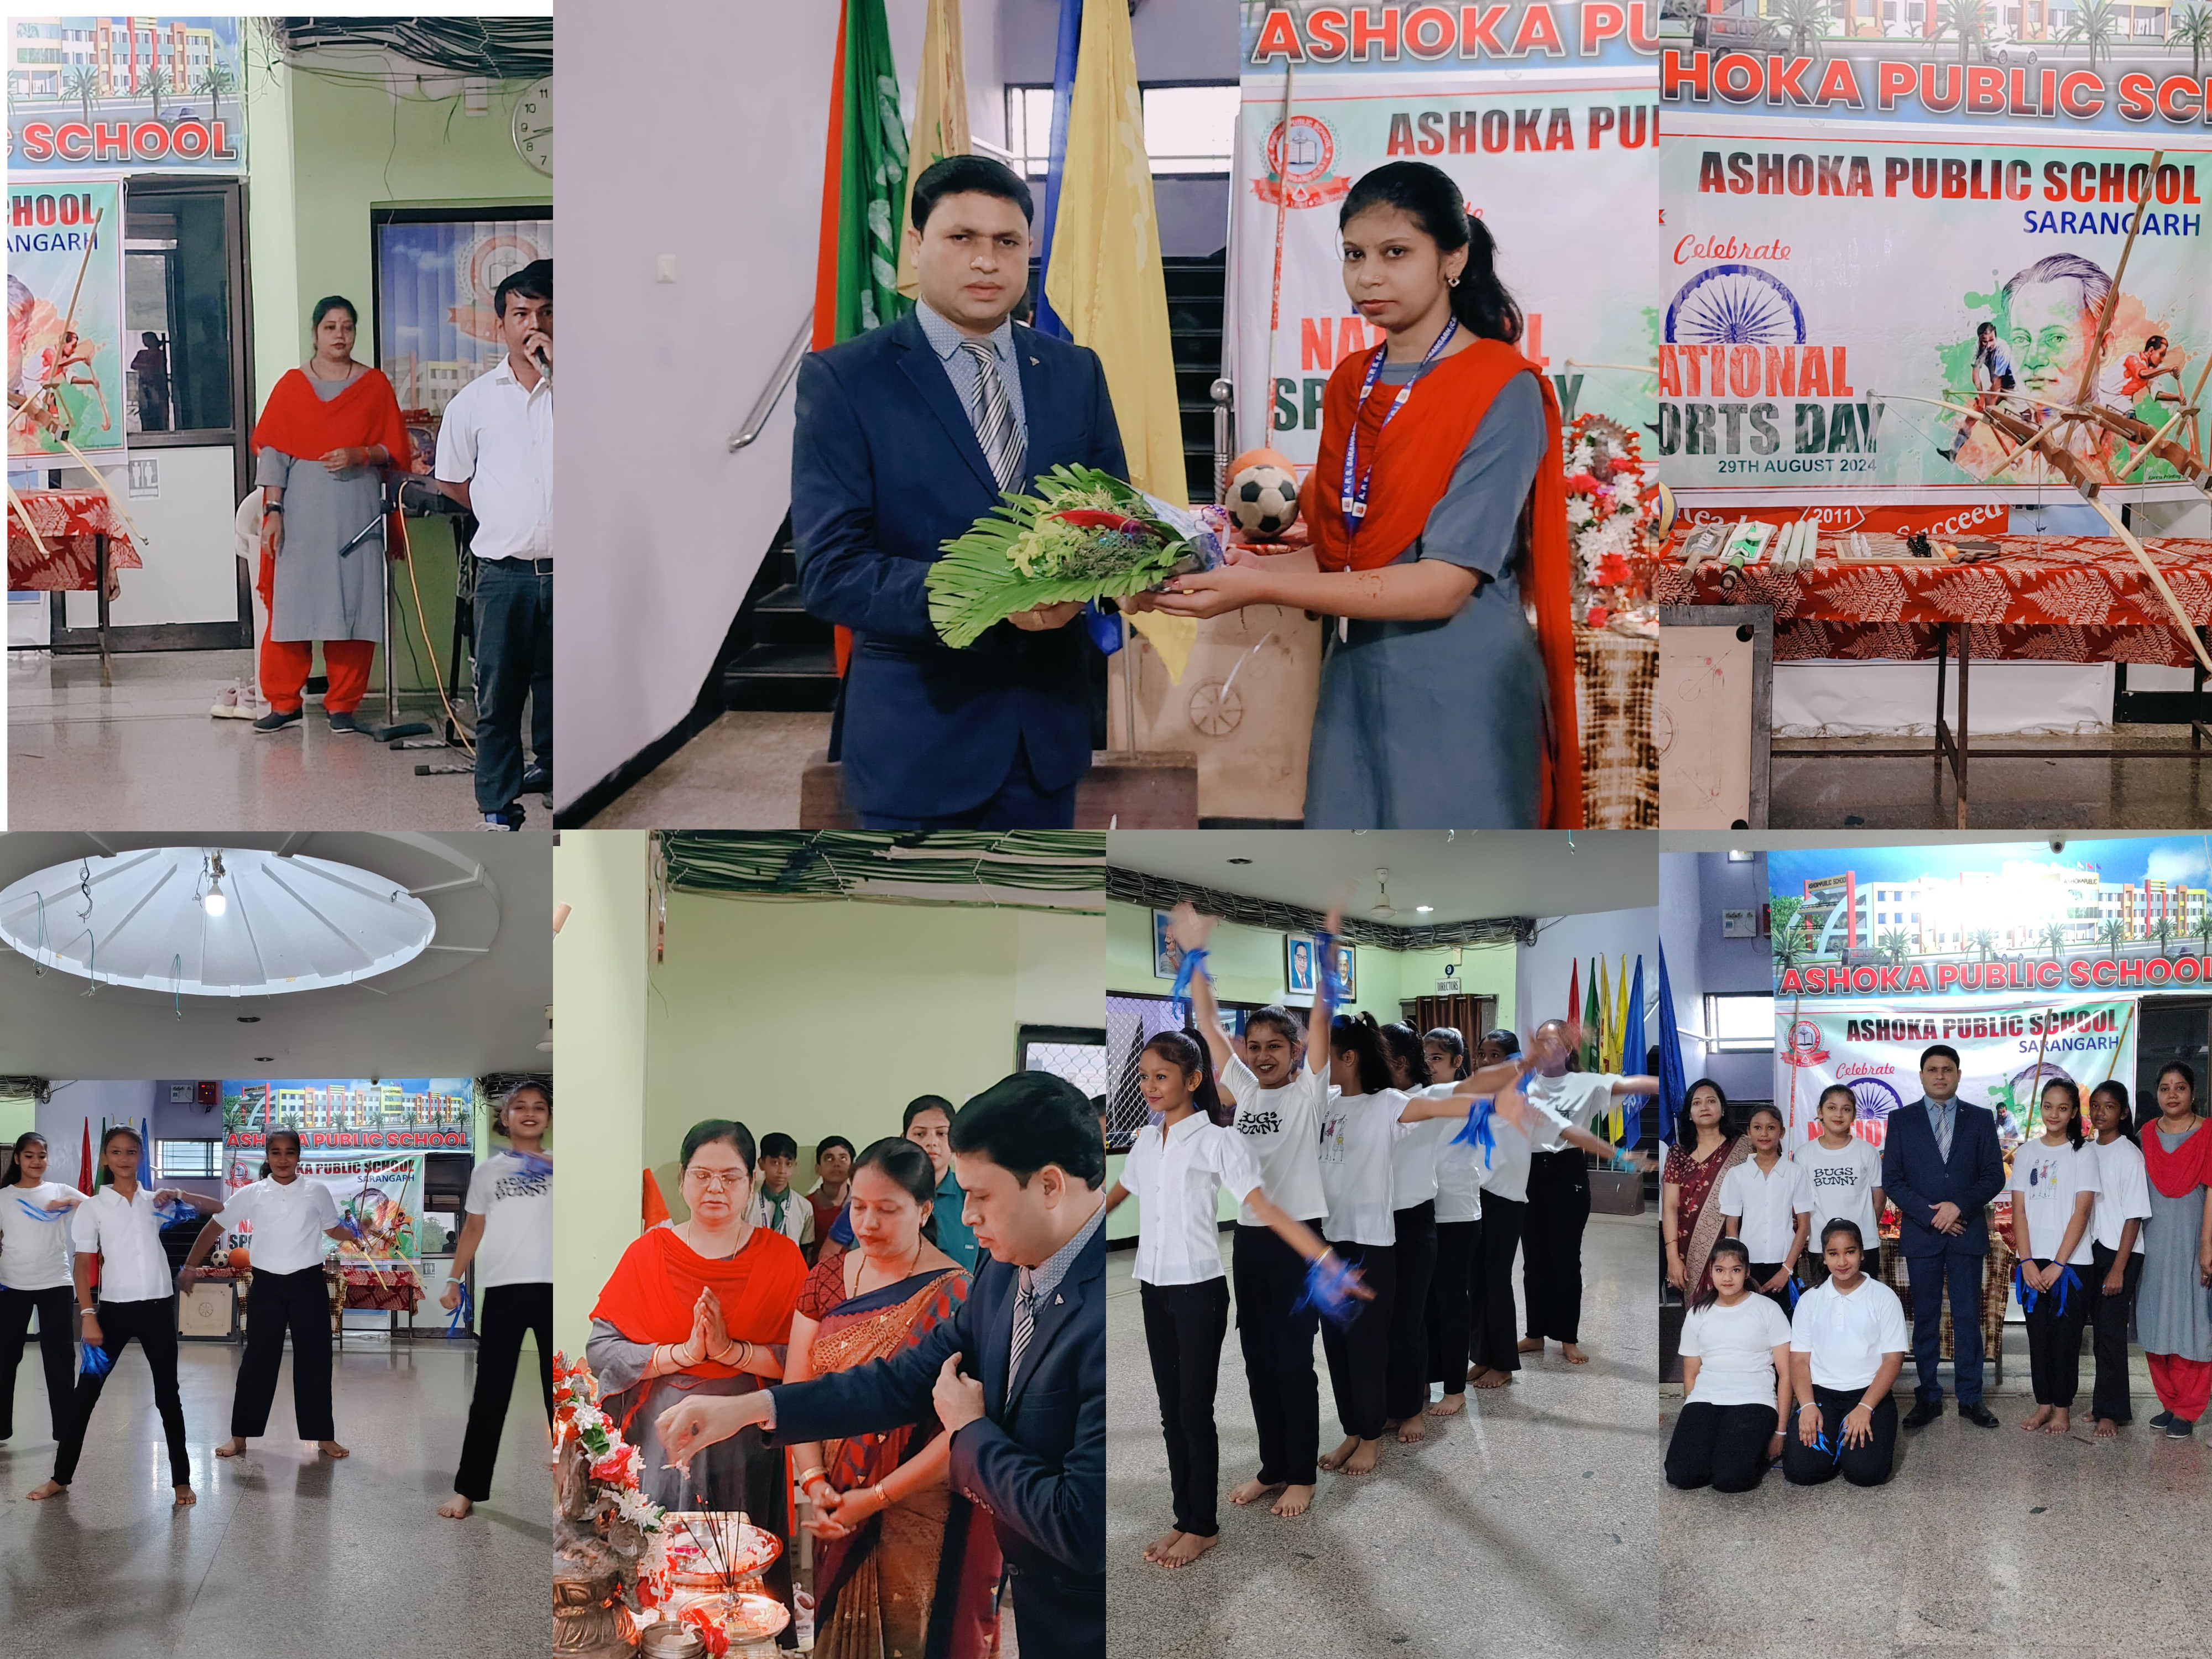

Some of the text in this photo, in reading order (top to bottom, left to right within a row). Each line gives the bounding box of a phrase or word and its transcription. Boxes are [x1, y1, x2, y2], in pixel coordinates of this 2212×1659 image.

[1250, 3, 1566, 64] ASHOKA
[1662, 49, 2212, 125] HOKA PUBLIC SC
[1386, 107, 1574, 156] ASHOKA
[23, 121, 237, 161] SCHOOL
[1697, 150, 2201, 205] ASHOKA PUBLIC SCHOOL
[2022, 209, 2200, 236] SARANGARH
[1673, 233, 1792, 266] Celebrate
[1795, 403, 1885, 454] DAY
[1718, 458, 1877, 473] 29TH AUGUST 2024
[1813, 508, 1851, 524] 2011
[1447, 966, 1452, 974] 9
[1778, 964, 1931, 995] ASHOKA
[1937, 961, 2062, 992] PUBLIC
[1437, 980, 1458, 992] DIRECTORS
[1846, 1009, 2119, 1042] ASHOKA PUBLIC SCHOOL
[2019, 1036, 2119, 1053] SARANGARH
[1835, 1062, 1895, 1079] Celebrate
[225, 1132, 471, 1149] ASHA PUBLIC SCHOOL
[316, 1161, 361, 1174] PUBLIC
[364, 1159, 415, 1173] SCHOOL
[1814, 1167, 1853, 1178] BUGS
[357, 1174, 415, 1183] SARANGARH
[1813, 1176, 1858, 1187] BUNNY
